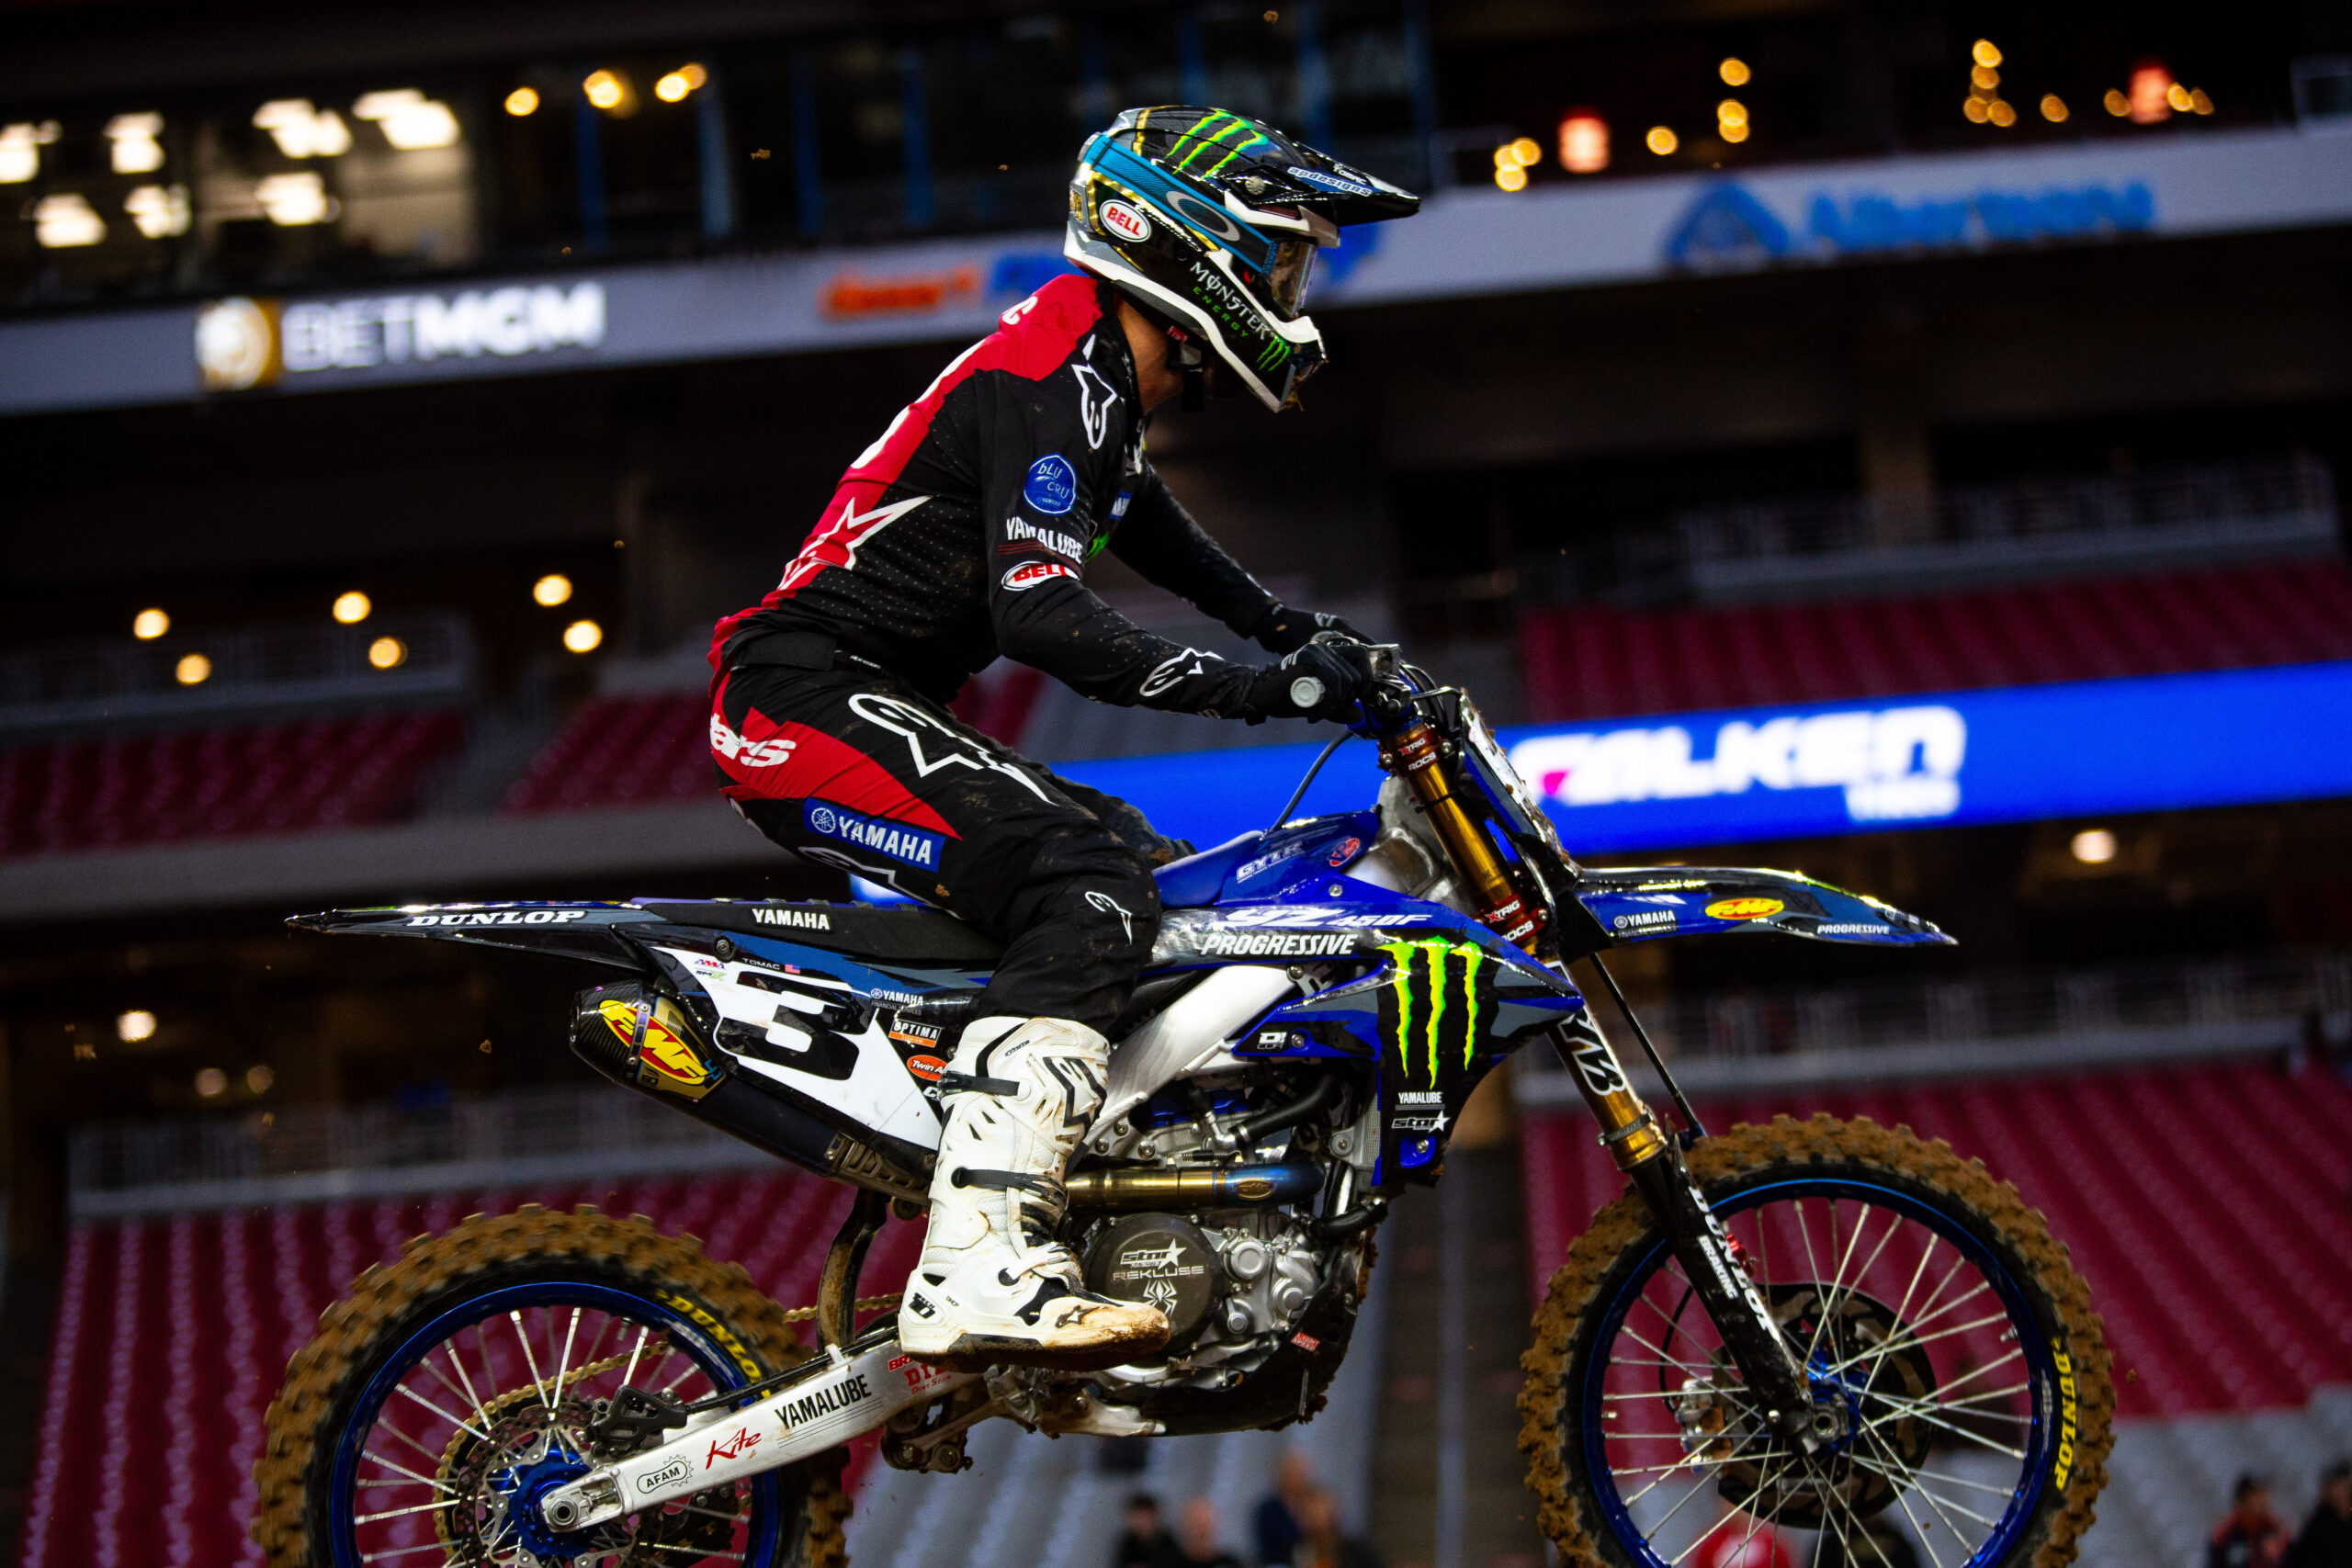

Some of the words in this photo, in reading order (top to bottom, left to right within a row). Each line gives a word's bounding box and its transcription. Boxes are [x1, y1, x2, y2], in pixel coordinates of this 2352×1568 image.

[1106, 206, 1140, 237] BELL
[1191, 261, 1266, 340] MONSTER
[1193, 287, 1250, 337] ENERGY
[281, 281, 608, 373] BETMGM
[1046, 481, 1070, 499] CRU
[1397, 738, 1426, 756] XTRIG
[1408, 752, 1437, 772] ROCS
[838, 816, 932, 865] YAMAHA
[406, 910, 586, 927] DUNLOP
[752, 908, 831, 931] YAMAHA
[1485, 900, 1521, 924] XTRIG
[1627, 909, 1676, 927] YAMAHA
[1817, 924, 1890, 935] PROGRESSIVE
[1200, 934, 1359, 956] PROGRESSIVE
[695, 959, 725, 970] AMA
[742, 958, 781, 970] TOMAC
[883, 990, 923, 1006] YAMAHA
[713, 970, 876, 1081] 3
[893, 1021, 938, 1040] OPTIMA
[912, 1059, 934, 1072] Twin
[1397, 1091, 1443, 1104] YAMALUBE
[1113, 1266, 1204, 1280] REKLUSE
[1698, 1235, 1738, 1299] BRAKING
[665, 1295, 763, 1383] DUNLO
[775, 1373, 872, 1429] YAMALUBE
[2052, 1351, 2076, 1491] DUNLOP
[705, 1427, 763, 1470] Kite
[645, 1466, 681, 1488] AFAM
